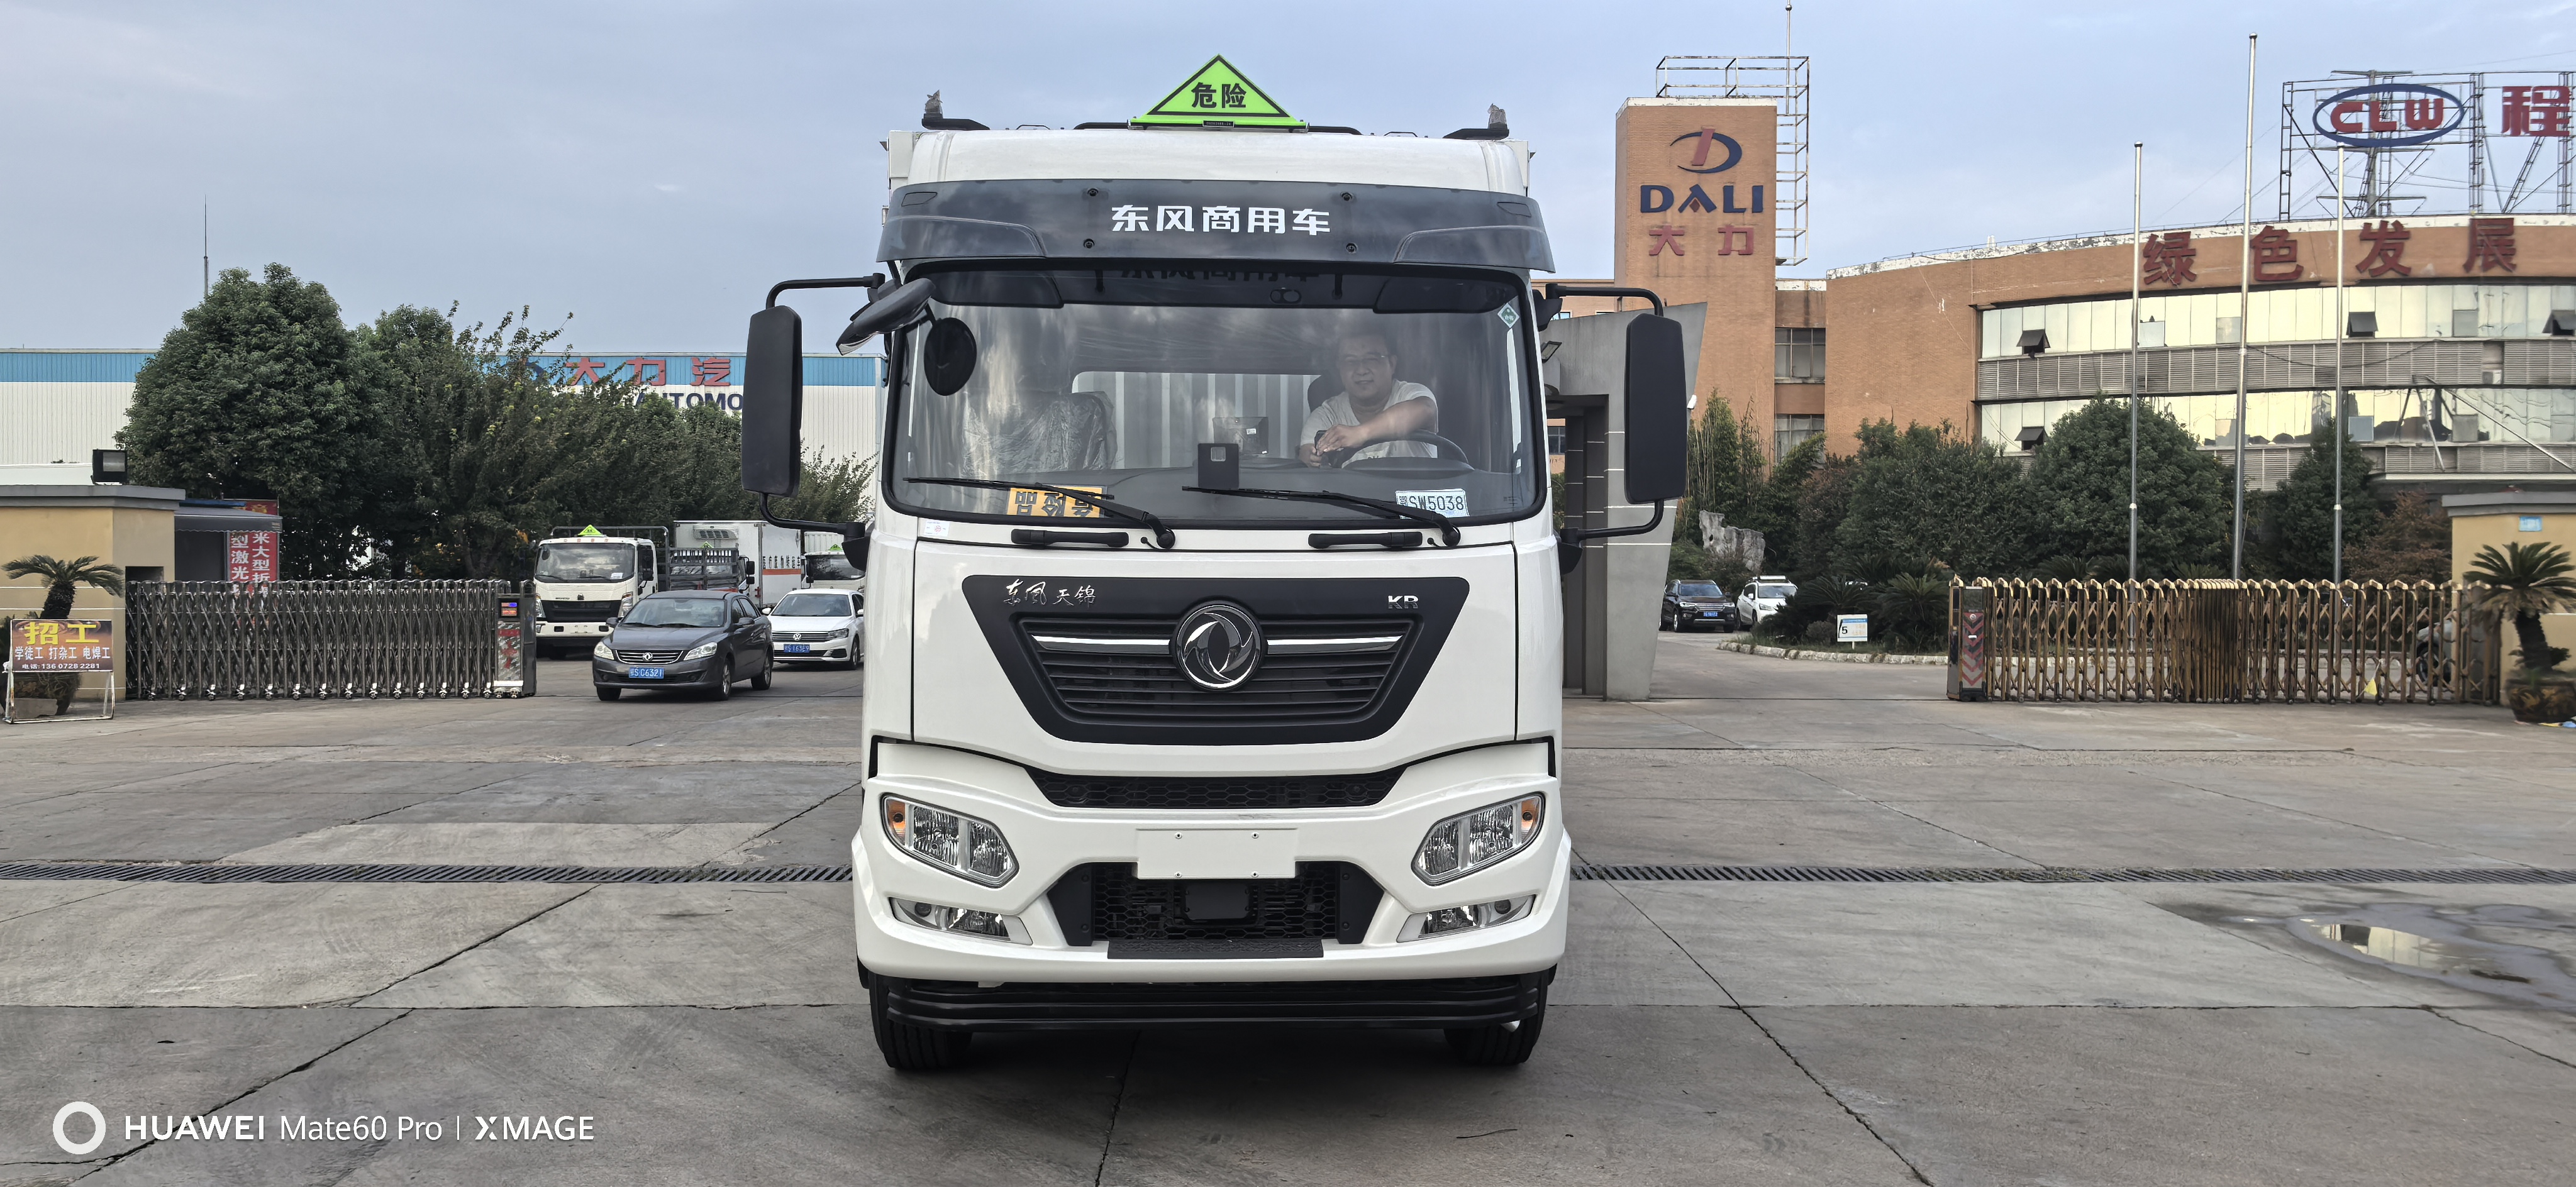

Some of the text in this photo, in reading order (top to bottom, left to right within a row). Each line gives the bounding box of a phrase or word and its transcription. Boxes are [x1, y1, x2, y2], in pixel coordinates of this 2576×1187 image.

[1191, 82, 1246, 108] 危险
[2331, 98, 2444, 133] CLW
[2502, 86, 2570, 136] 程
[1640, 184, 1763, 213] DALI
[1112, 205, 1330, 236] 东风商用车
[1648, 224, 1754, 255] 大力
[2143, 218, 2517, 285] 绿色发展
[1388, 595, 1419, 609] KR
[25, 622, 99, 645] 招工
[15, 646, 110, 660] 学徒工 打杂工 电焊工
